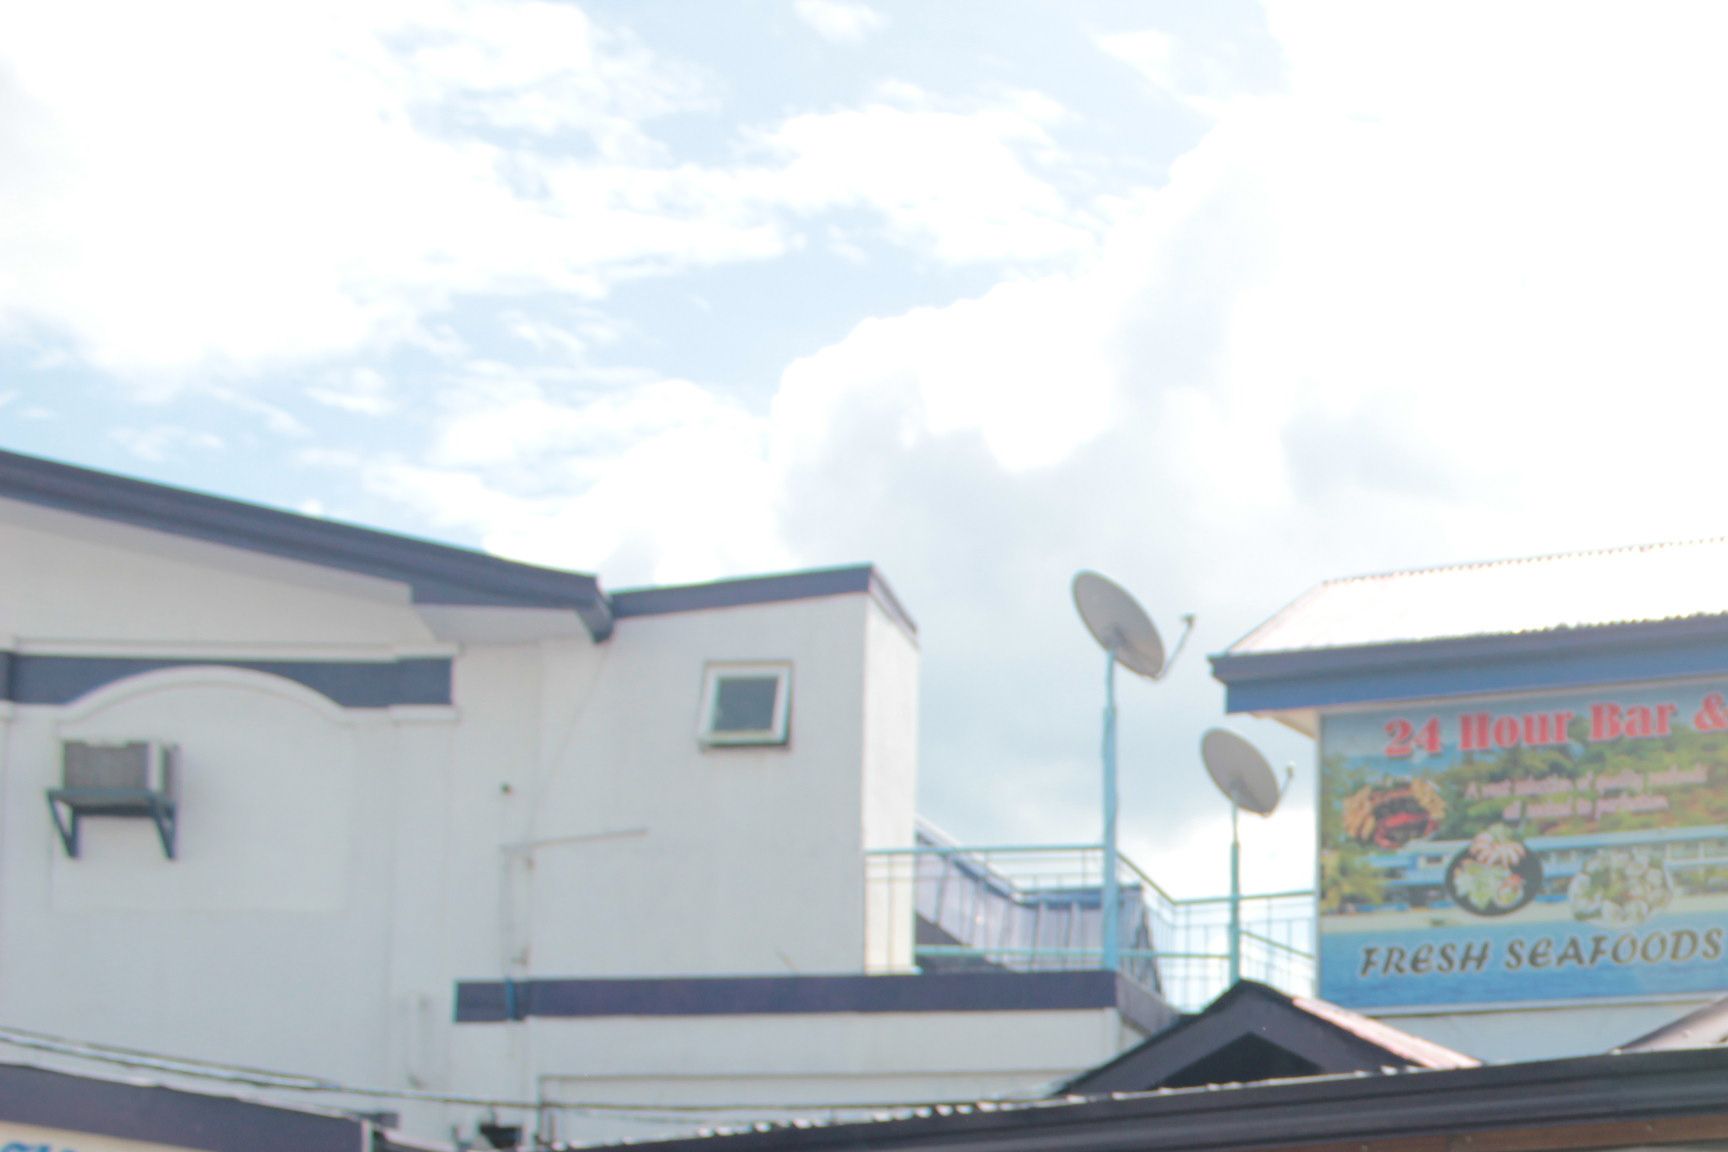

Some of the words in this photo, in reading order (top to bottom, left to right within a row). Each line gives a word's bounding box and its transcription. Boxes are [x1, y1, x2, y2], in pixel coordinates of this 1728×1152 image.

[1384, 716, 1442, 760] 24
[1458, 711, 1576, 752] Hour
[1589, 702, 1677, 742] Bar
[1359, 941, 1491, 978] FRESH
[1503, 928, 1725, 972] SEAFOODS
